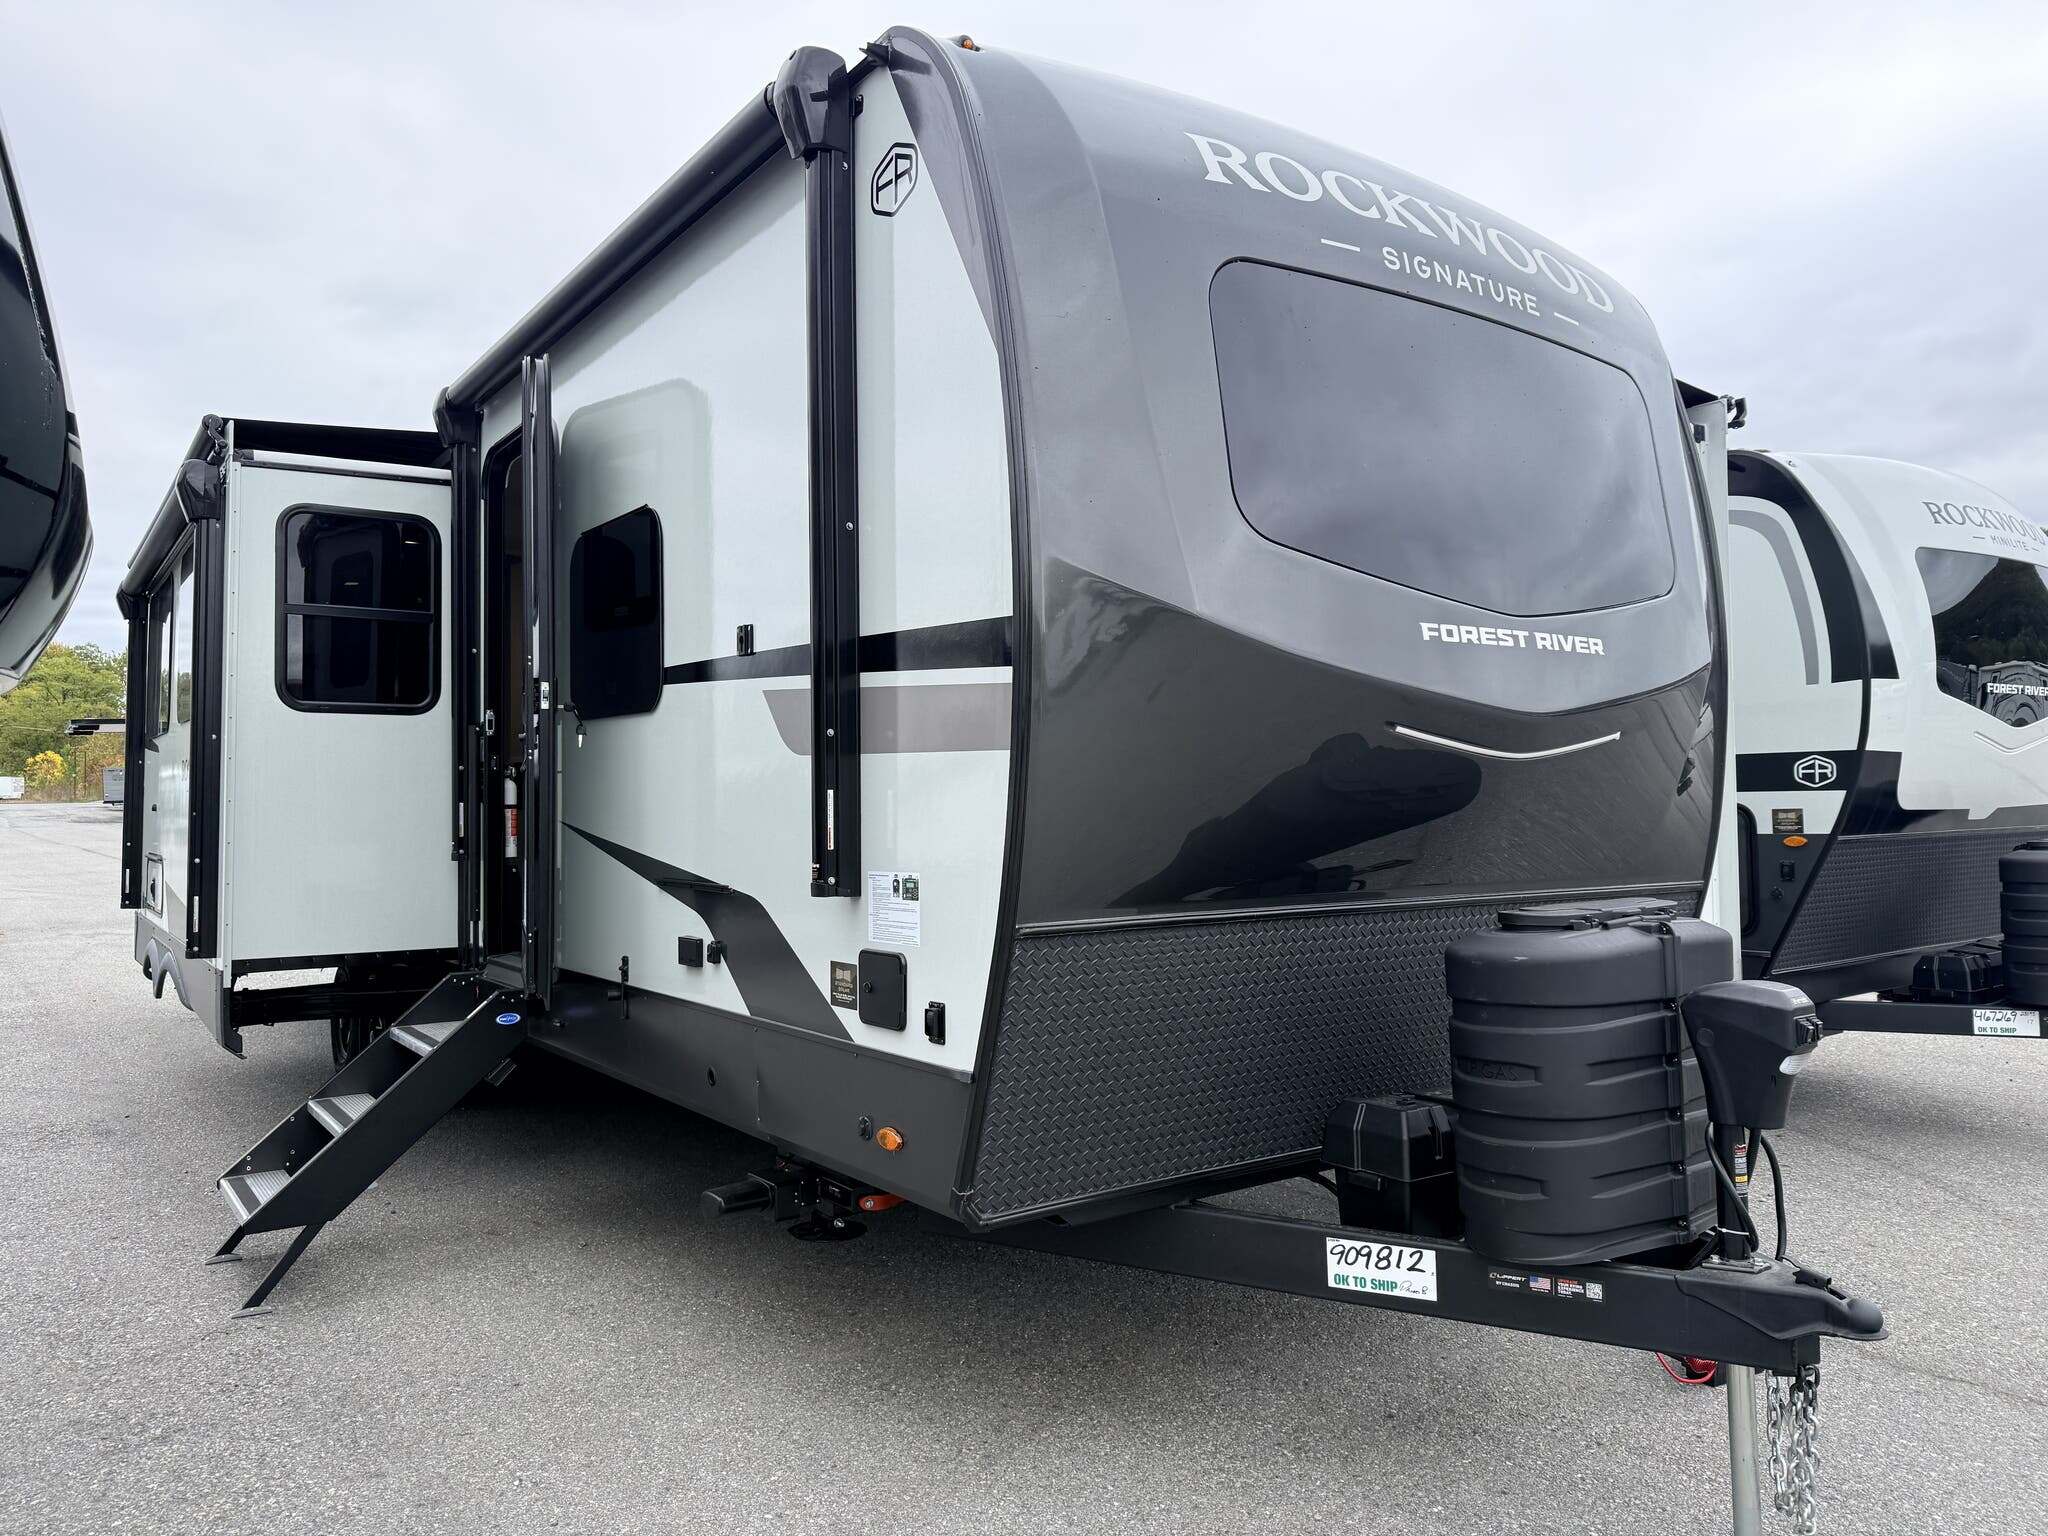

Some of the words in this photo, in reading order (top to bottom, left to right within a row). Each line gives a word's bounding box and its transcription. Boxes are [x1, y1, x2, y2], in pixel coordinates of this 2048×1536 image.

[1183, 131, 1615, 314] ROCKWOOD
[1381, 246, 1541, 317] SIGNATURE
[1921, 501, 2046, 546] ROCKWOOD
[1419, 622, 1530, 648] FOREST
[1532, 631, 1606, 656] RIVER
[1986, 682, 2024, 695] FOREST
[1974, 1010, 2018, 1023] 467269
[1330, 1244, 1426, 1273] 909812
[1333, 1273, 1350, 1287] OK
[1352, 1276, 1367, 1289] TO
[1370, 1278, 1398, 1292] SHIP
